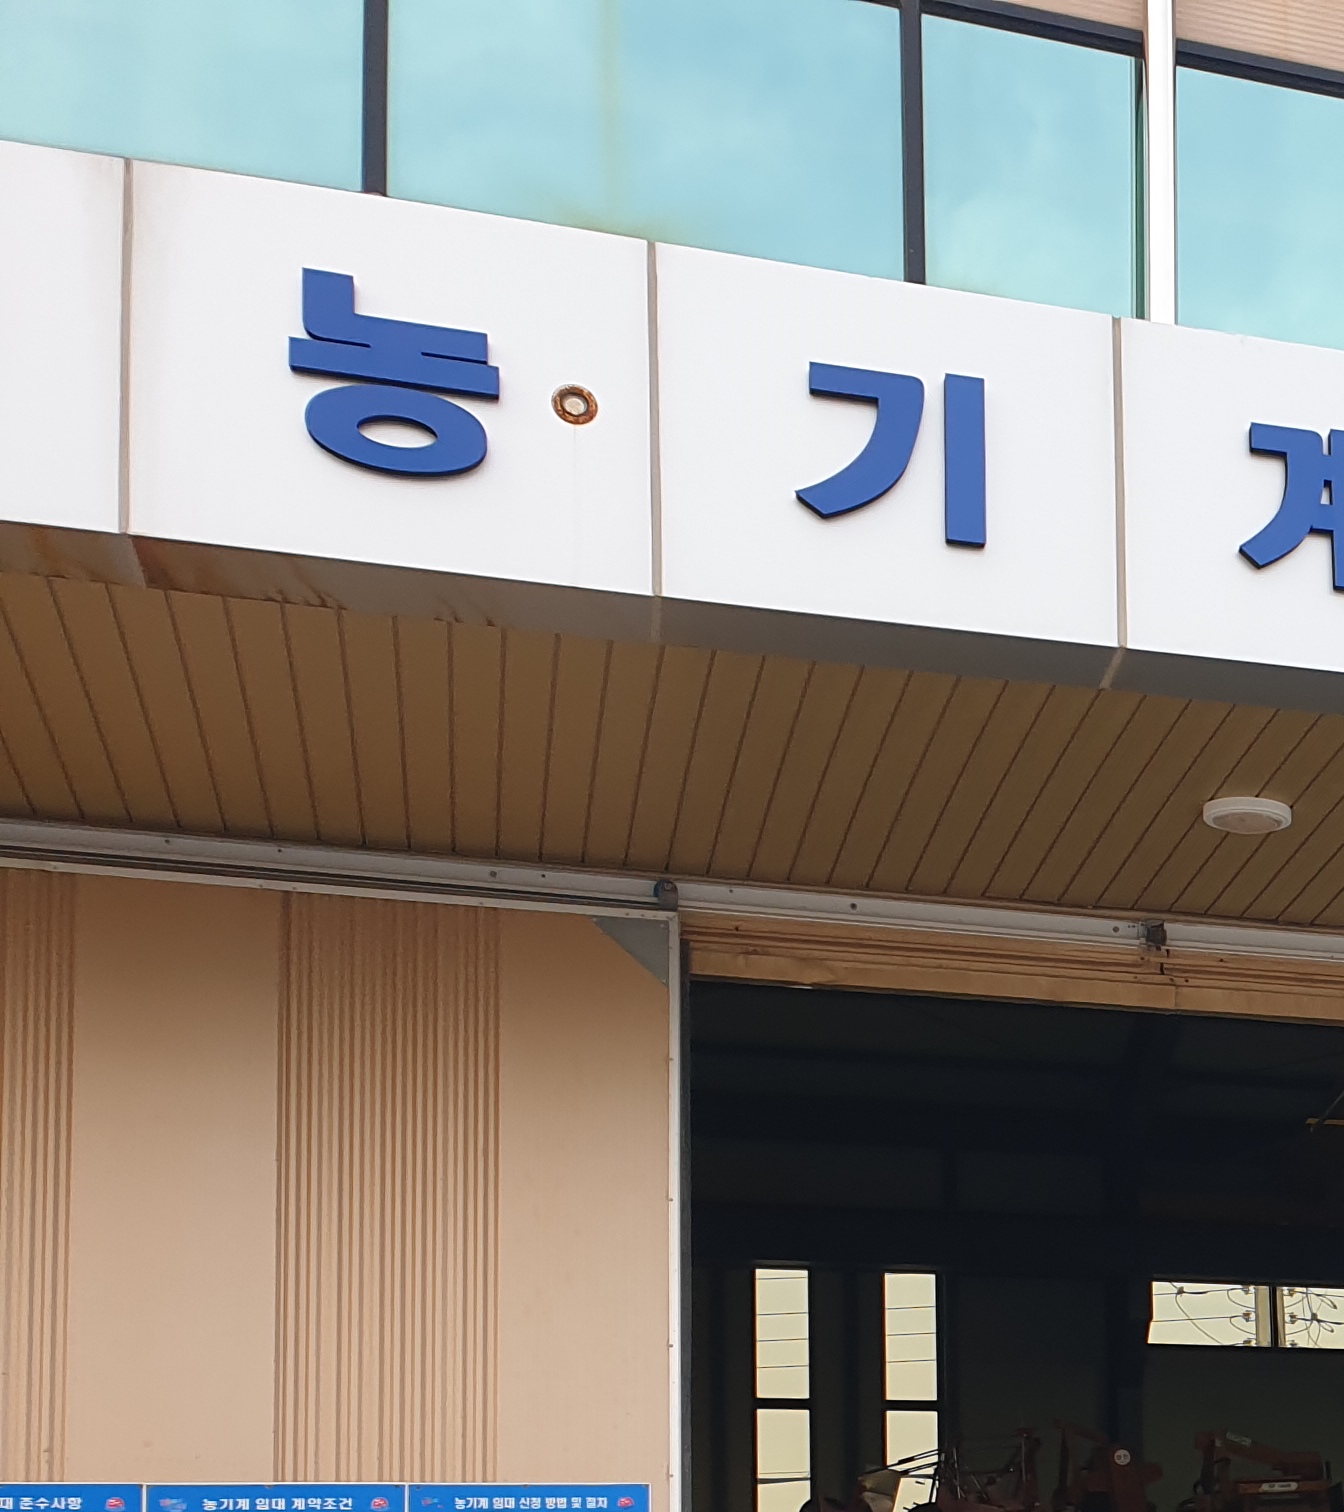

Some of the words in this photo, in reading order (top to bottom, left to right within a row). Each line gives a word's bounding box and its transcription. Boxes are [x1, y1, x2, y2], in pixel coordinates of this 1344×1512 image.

[19, 1497, 82, 1510] 준수사항
[202, 1497, 249, 1511] 농기계
[255, 1497, 286, 1511] 임대
[291, 1496, 353, 1510] 계약조건
[454, 1496, 488, 1509] 농기계
[492, 1496, 515, 1509] 임대
[519, 1496, 541, 1508] 신청
[545, 1496, 567, 1508] 방법
